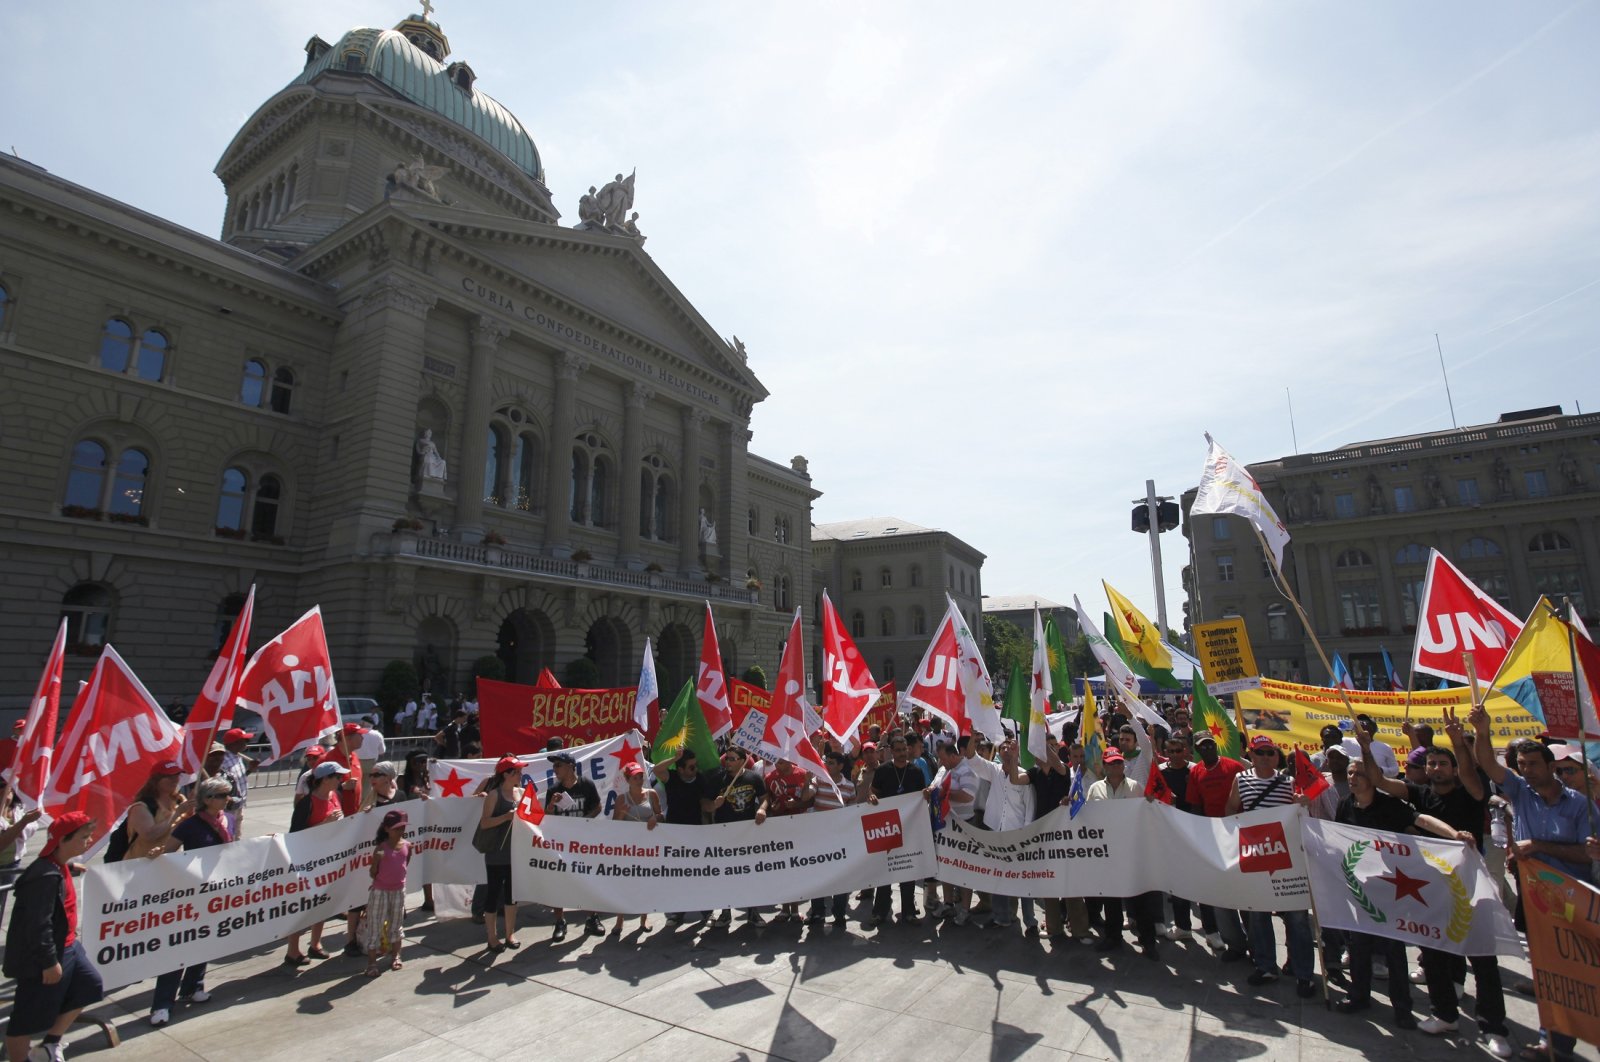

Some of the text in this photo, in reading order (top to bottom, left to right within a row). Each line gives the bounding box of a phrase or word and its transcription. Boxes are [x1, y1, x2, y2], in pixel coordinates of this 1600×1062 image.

[462, 277, 720, 405] CURIA CONFOEDERATIONIS HELVETICAE
[1209, 647, 1239, 657] racisme
[1264, 691, 1291, 701] keine
[1295, 693, 1360, 704] Gnadenate
[1363, 695, 1395, 705] durch
[1305, 712, 1350, 721] Nessuno
[1375, 714, 1414, 724] traniero
[1505, 714, 1537, 723] terra
[1499, 727, 1511, 736] di
[1514, 726, 1541, 737] noi!
[531, 834, 794, 858] Kein Rentenklau! Faire Altersrenten
[934, 832, 979, 855] chweiz
[1016, 848, 1045, 862] auch
[1049, 844, 1109, 859] unsere!
[988, 844, 1016, 853] und
[1020, 828, 1073, 849] Normen
[1077, 826, 1105, 840] der
[1373, 839, 1411, 857] PYD
[529, 847, 847, 877] auch für Arbeitnehmende aus dem Kosovo!
[936, 854, 1055, 879] va-Albaner in der Schweiz
[101, 898, 138, 915] Unia
[142, 887, 195, 906] Region
[199, 875, 244, 894] Zürich
[247, 867, 284, 885] gegen
[288, 844, 358, 872] Ausgrenzung
[99, 902, 200, 941] Freiheit,
[207, 877, 311, 914] Gleichheit
[315, 863, 347, 888] und
[97, 892, 332, 965] Ohne uns geht nichts.
[1396, 918, 1441, 940] 2003
[1536, 968, 1598, 1018] FREIHEIT
